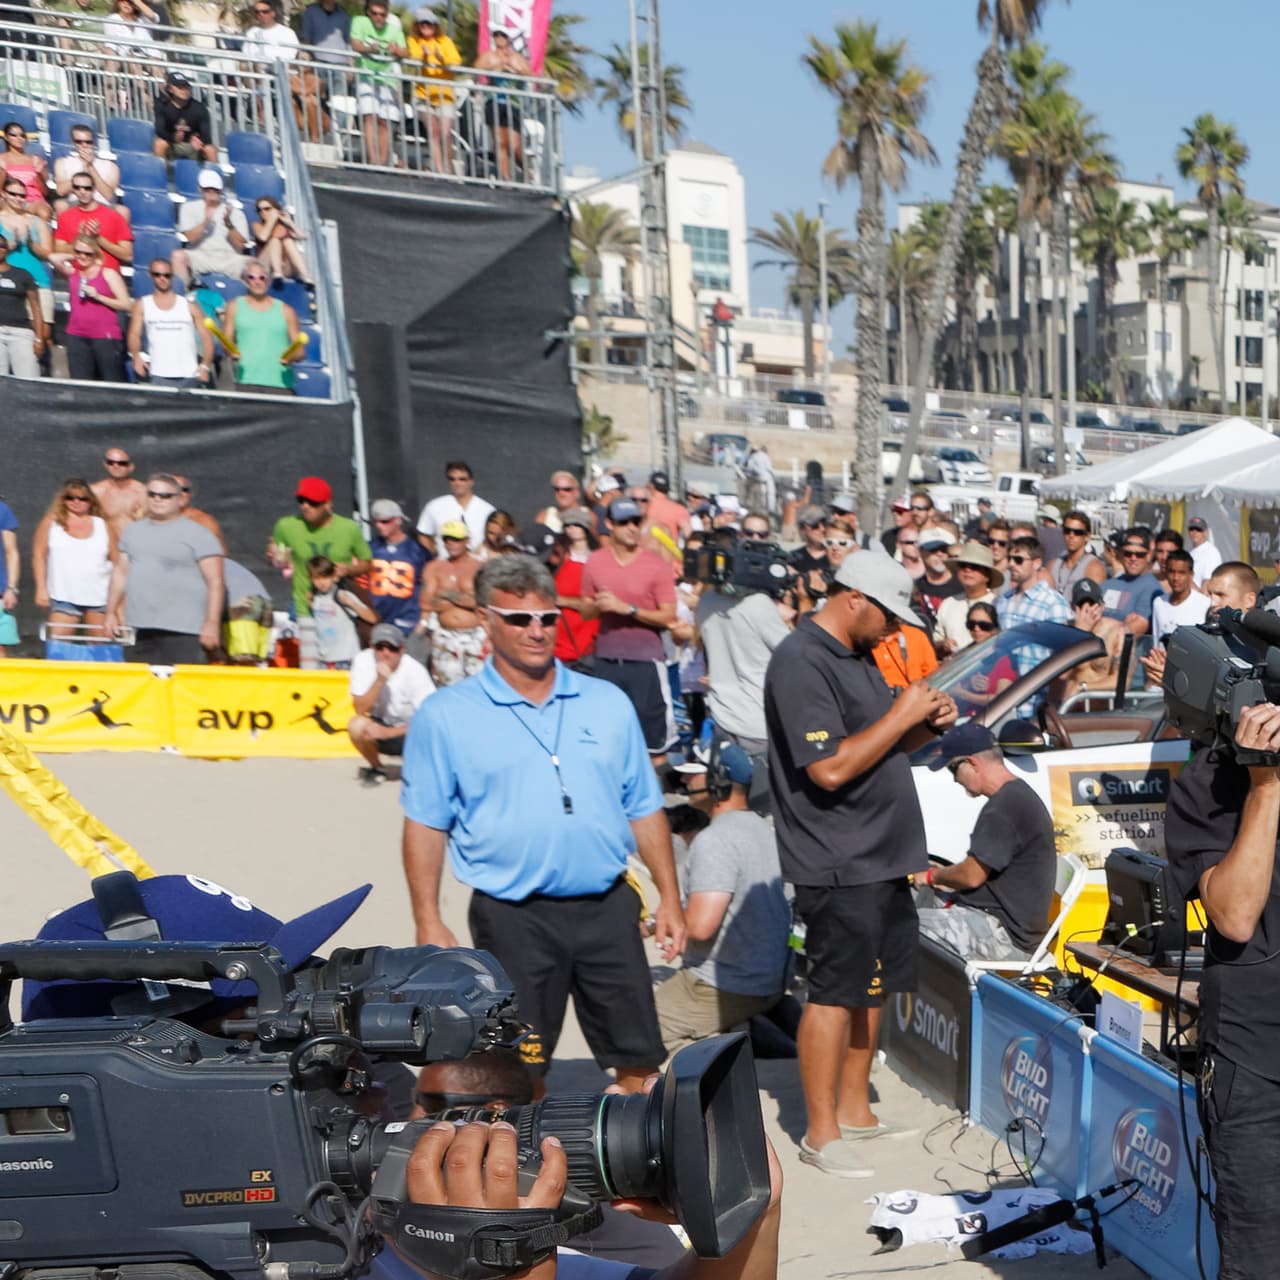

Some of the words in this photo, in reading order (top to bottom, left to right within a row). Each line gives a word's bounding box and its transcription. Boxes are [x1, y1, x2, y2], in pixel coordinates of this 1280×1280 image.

[0, 703, 50, 732] vp
[198, 708, 274, 734] avp
[1105, 777, 1163, 797] smart
[1099, 827, 1156, 841] station
[913, 998, 961, 1063] smart
[1015, 1050, 1048, 1090] BUD
[1007, 1071, 1049, 1116] LIGHT
[1131, 1123, 1172, 1168] BUD
[251, 1170, 272, 1182] EX
[1122, 1146, 1175, 1199] LIGHT
[184, 1191, 243, 1205] DVCPRO
[246, 1188, 274, 1201] HD
[404, 1223, 455, 1243] Canon
